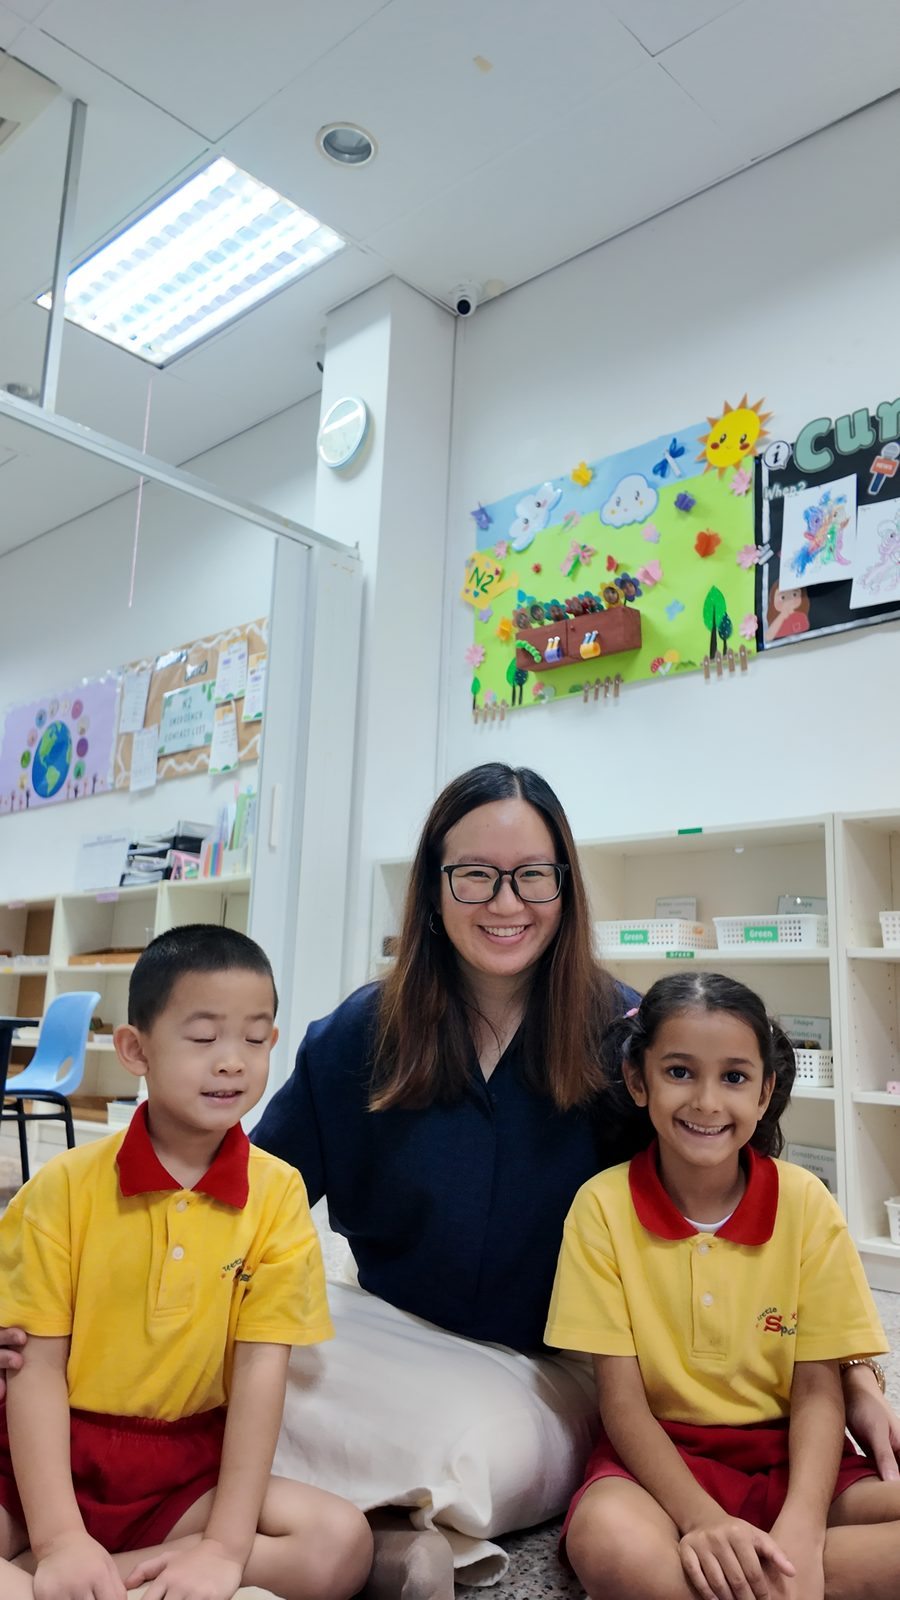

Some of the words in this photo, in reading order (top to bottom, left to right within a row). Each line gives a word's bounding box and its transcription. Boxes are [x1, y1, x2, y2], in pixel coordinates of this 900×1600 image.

[468, 567, 494, 594] N2
[623, 933, 644, 941] Green
[749, 929, 773, 938] Green
